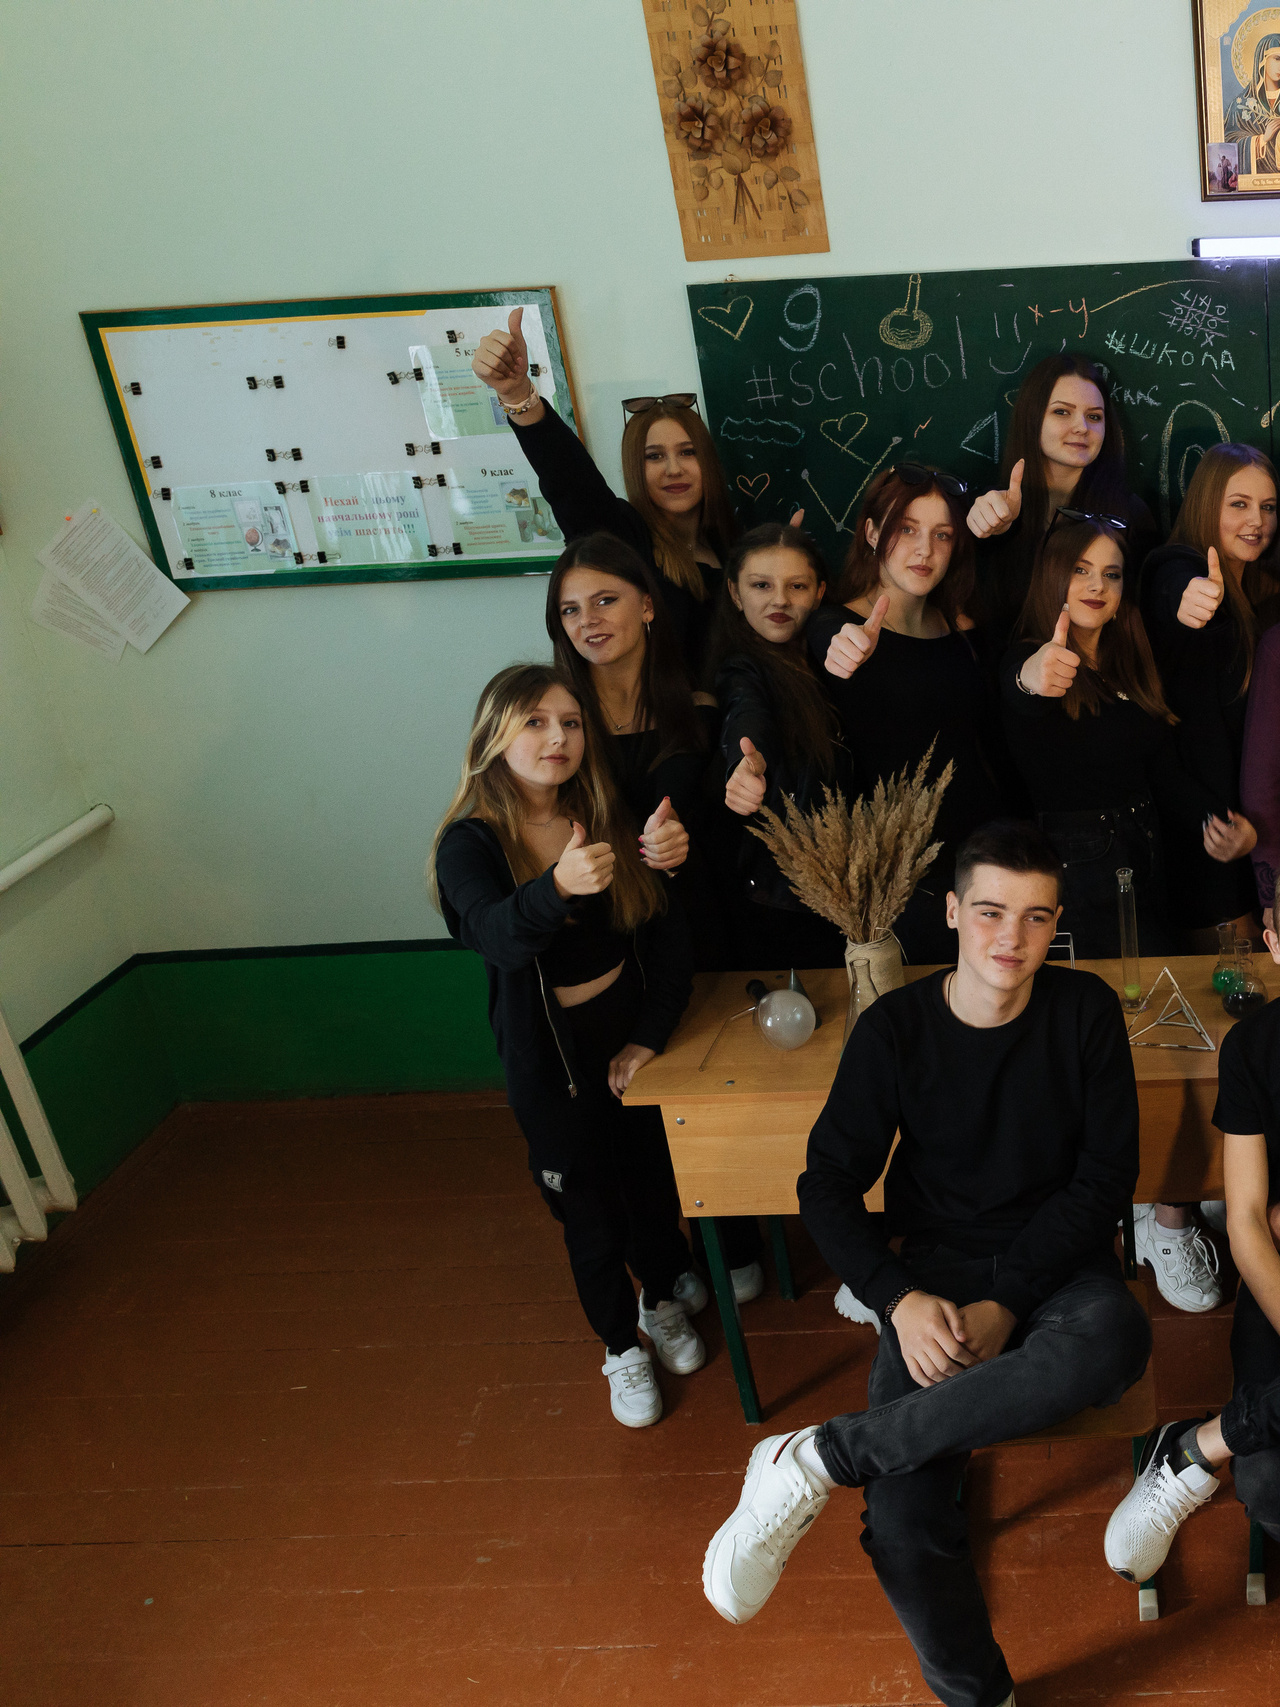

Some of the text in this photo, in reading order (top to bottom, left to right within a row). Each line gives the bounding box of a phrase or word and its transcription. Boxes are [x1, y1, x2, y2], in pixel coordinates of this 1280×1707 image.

[777, 283, 822, 352] 9
[480, 468, 515, 478] 9 клас
[209, 489, 242, 498] 8 клас
[323, 495, 359, 507] Нехай
[317, 508, 420, 523] навчальному році
